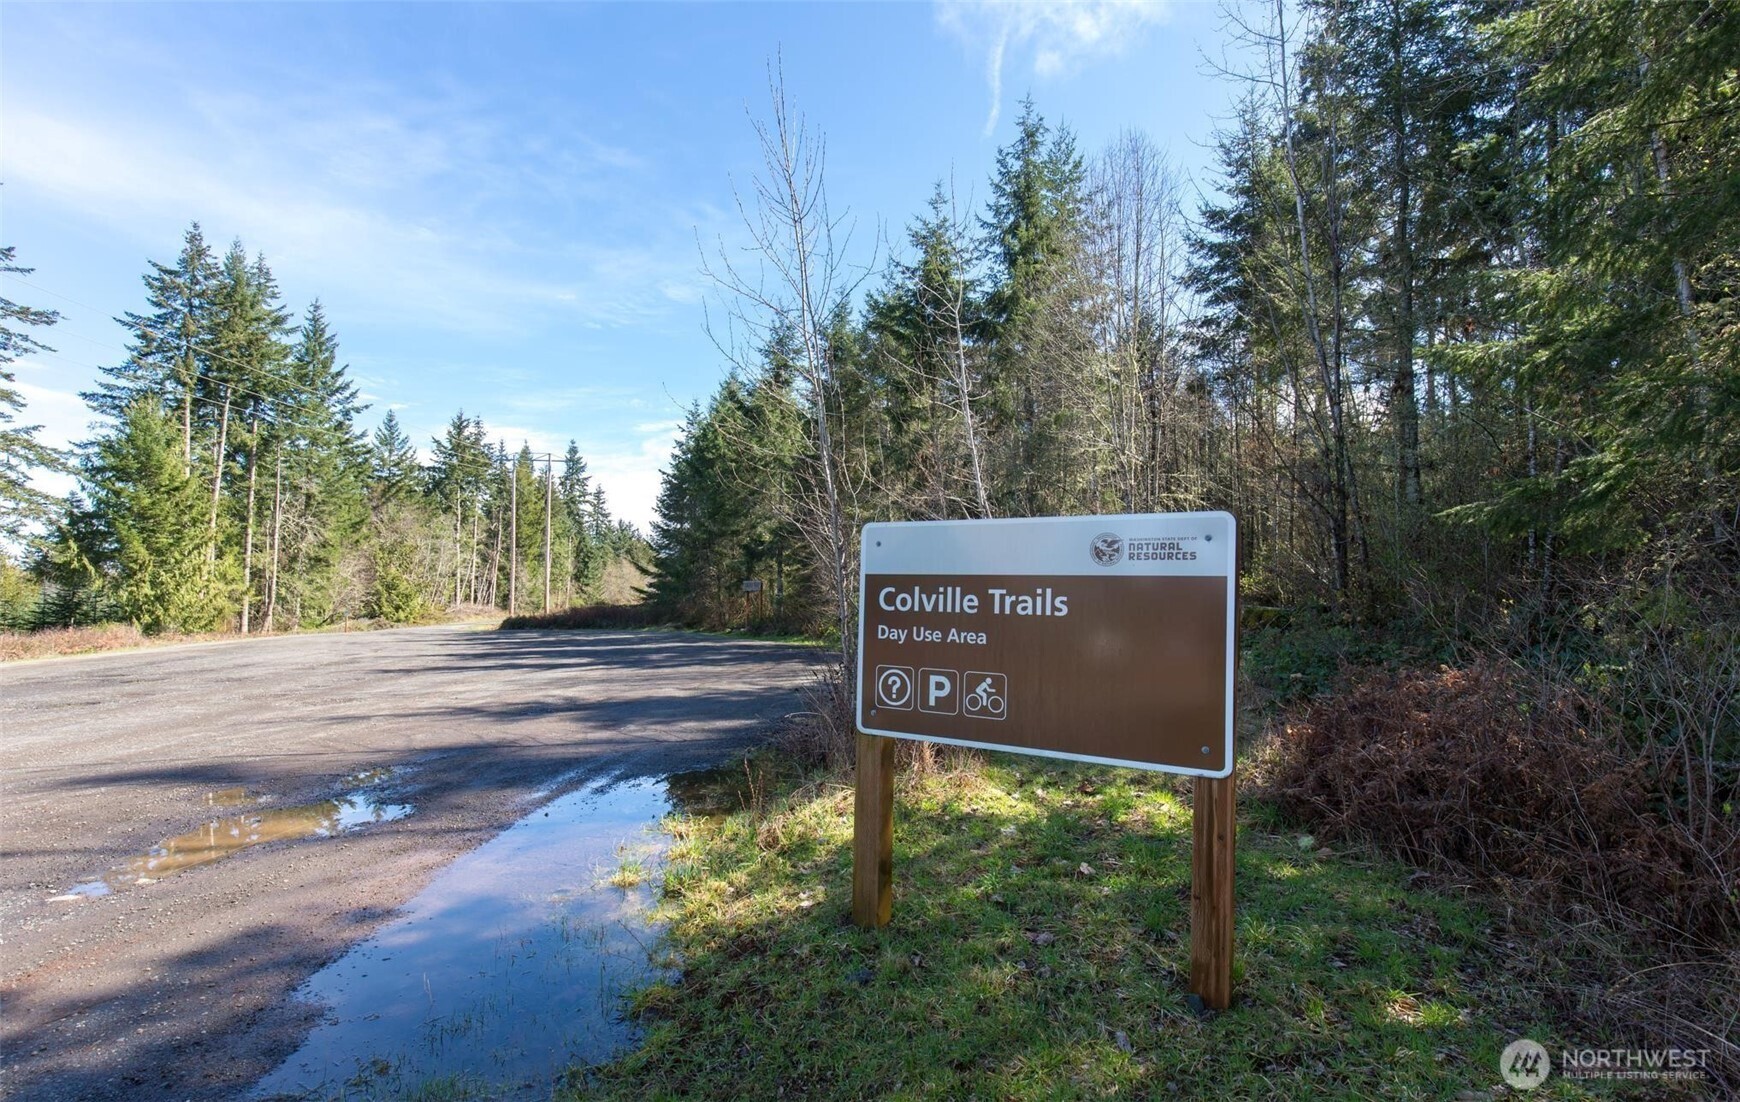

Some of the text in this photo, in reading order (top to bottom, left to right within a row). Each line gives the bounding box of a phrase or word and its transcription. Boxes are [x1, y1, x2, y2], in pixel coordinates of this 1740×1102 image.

[1128, 542, 1183, 551] NATURAL
[1128, 551, 1197, 561] RESOURCES
[878, 586, 1069, 617] Colville Trails
[877, 625, 987, 645] Day Use Area
[928, 674, 951, 706] P
